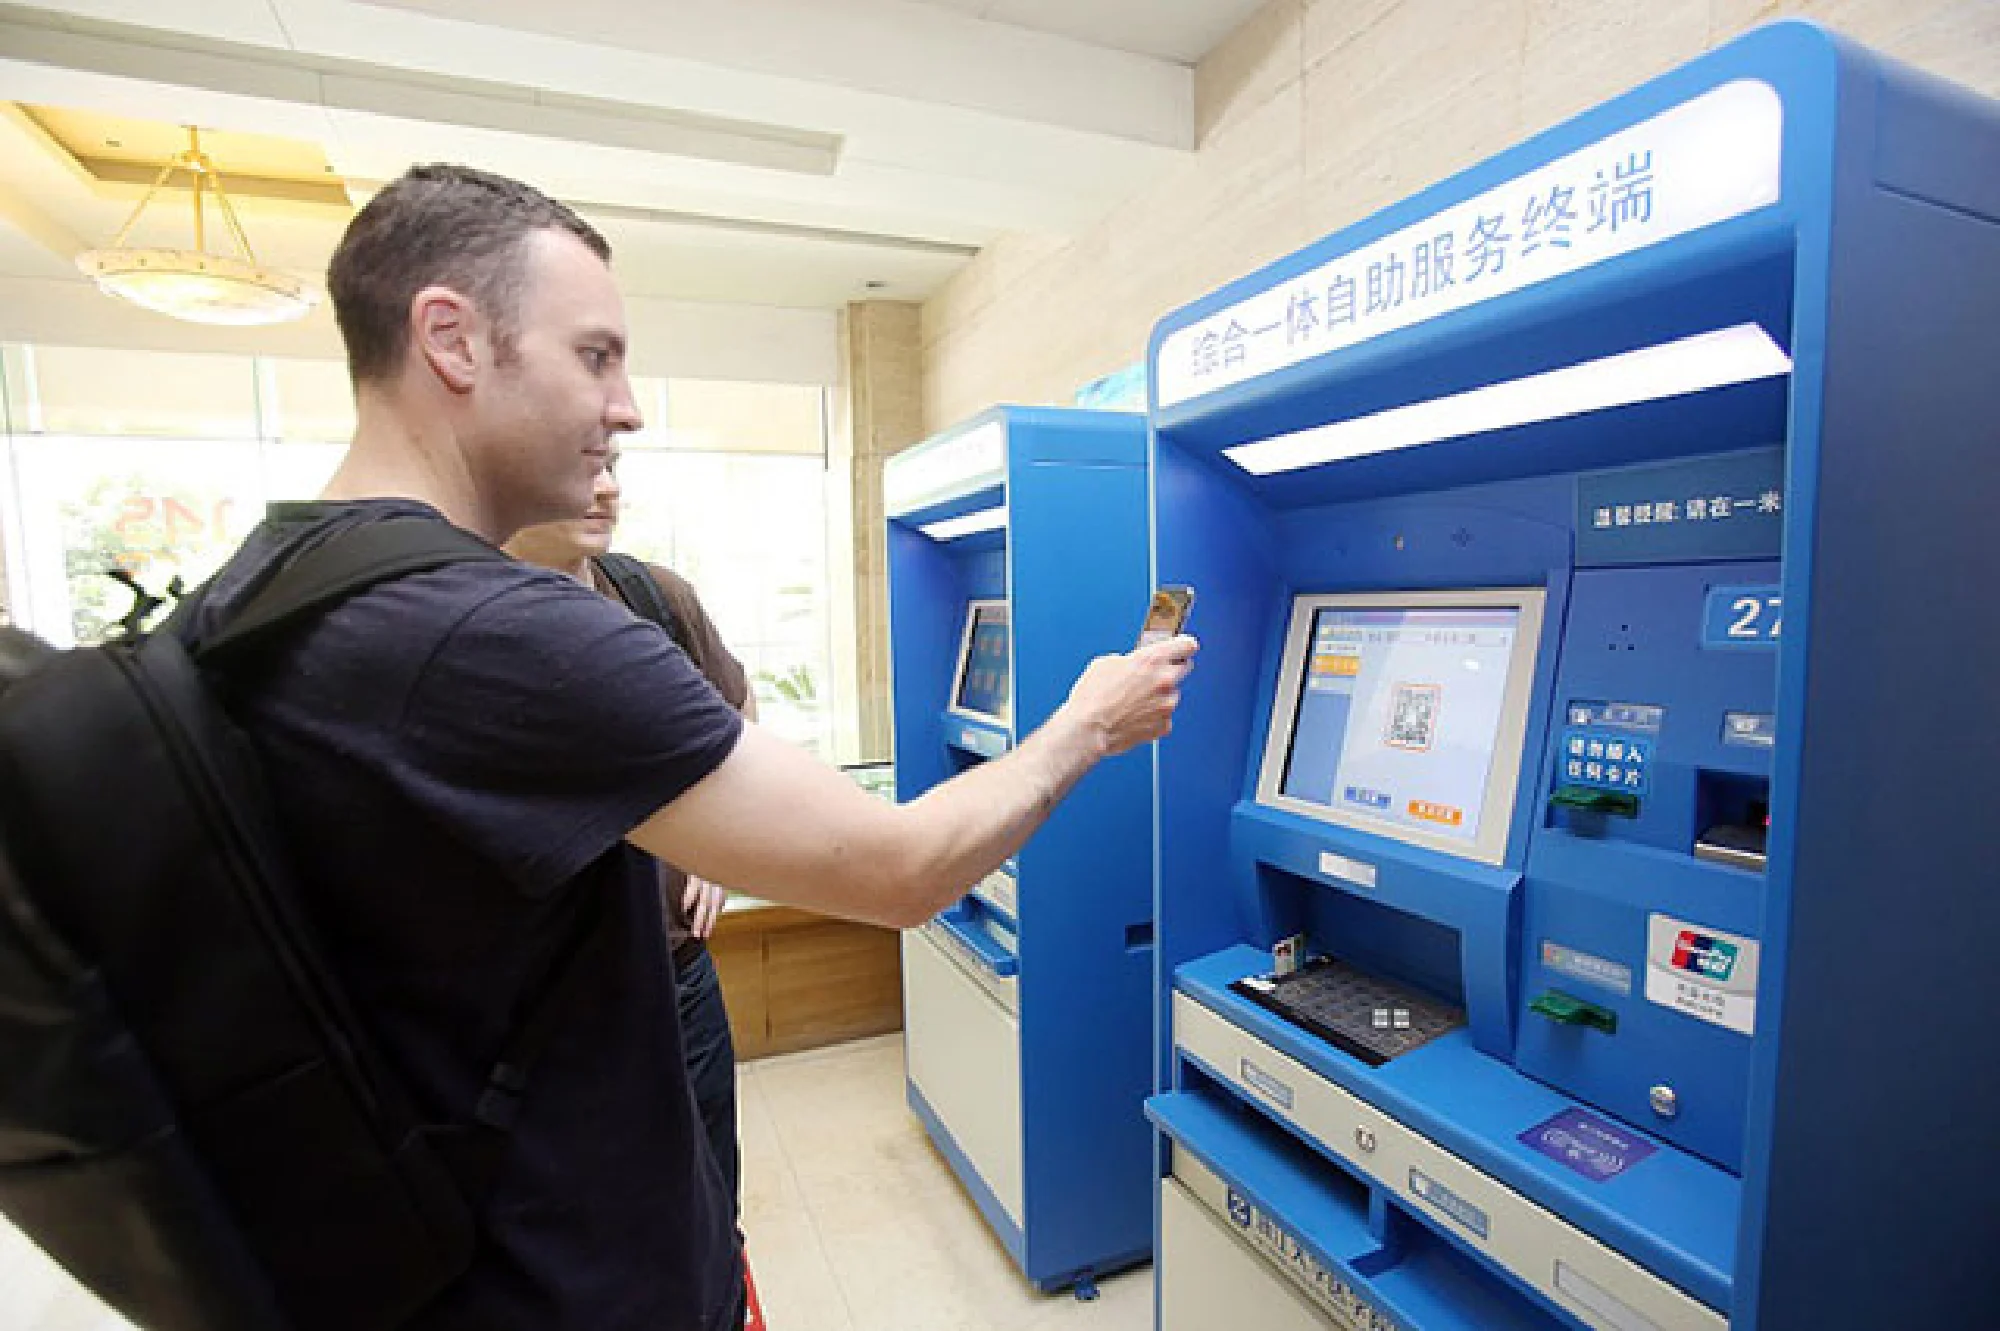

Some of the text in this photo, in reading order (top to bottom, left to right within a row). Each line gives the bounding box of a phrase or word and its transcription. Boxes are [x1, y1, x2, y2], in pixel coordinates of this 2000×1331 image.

[1190, 149, 1655, 377] 综合一体自助服务终端
